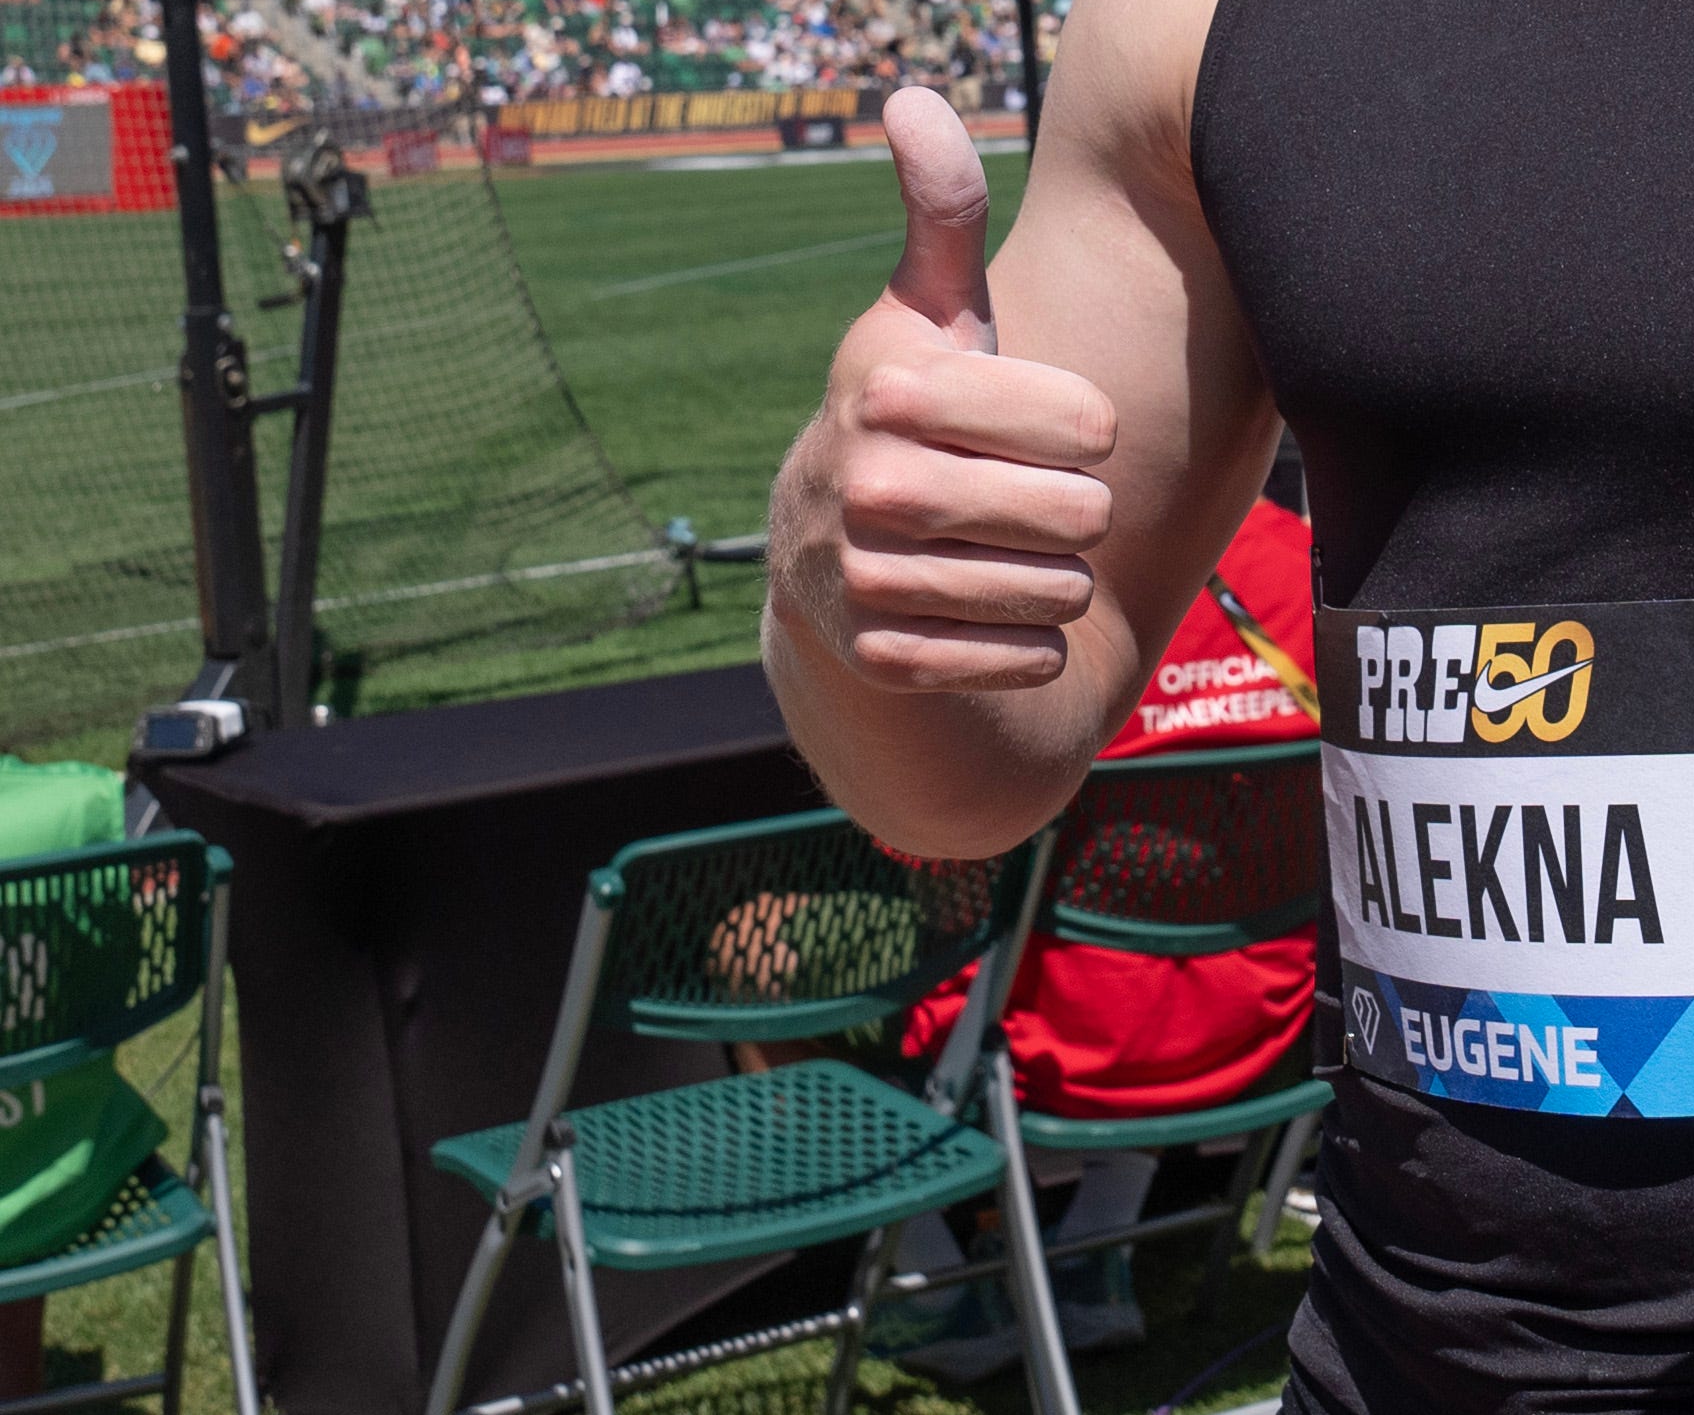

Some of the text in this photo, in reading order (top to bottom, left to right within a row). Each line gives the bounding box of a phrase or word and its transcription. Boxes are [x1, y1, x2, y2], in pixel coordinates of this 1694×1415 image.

[1158, 651, 1278, 695] OFFICIA
[1140, 686, 1301, 733] TIMEKEEPE
[1353, 795, 1665, 944] ALEKNA
[1400, 1005, 1601, 1087] EUGENE
